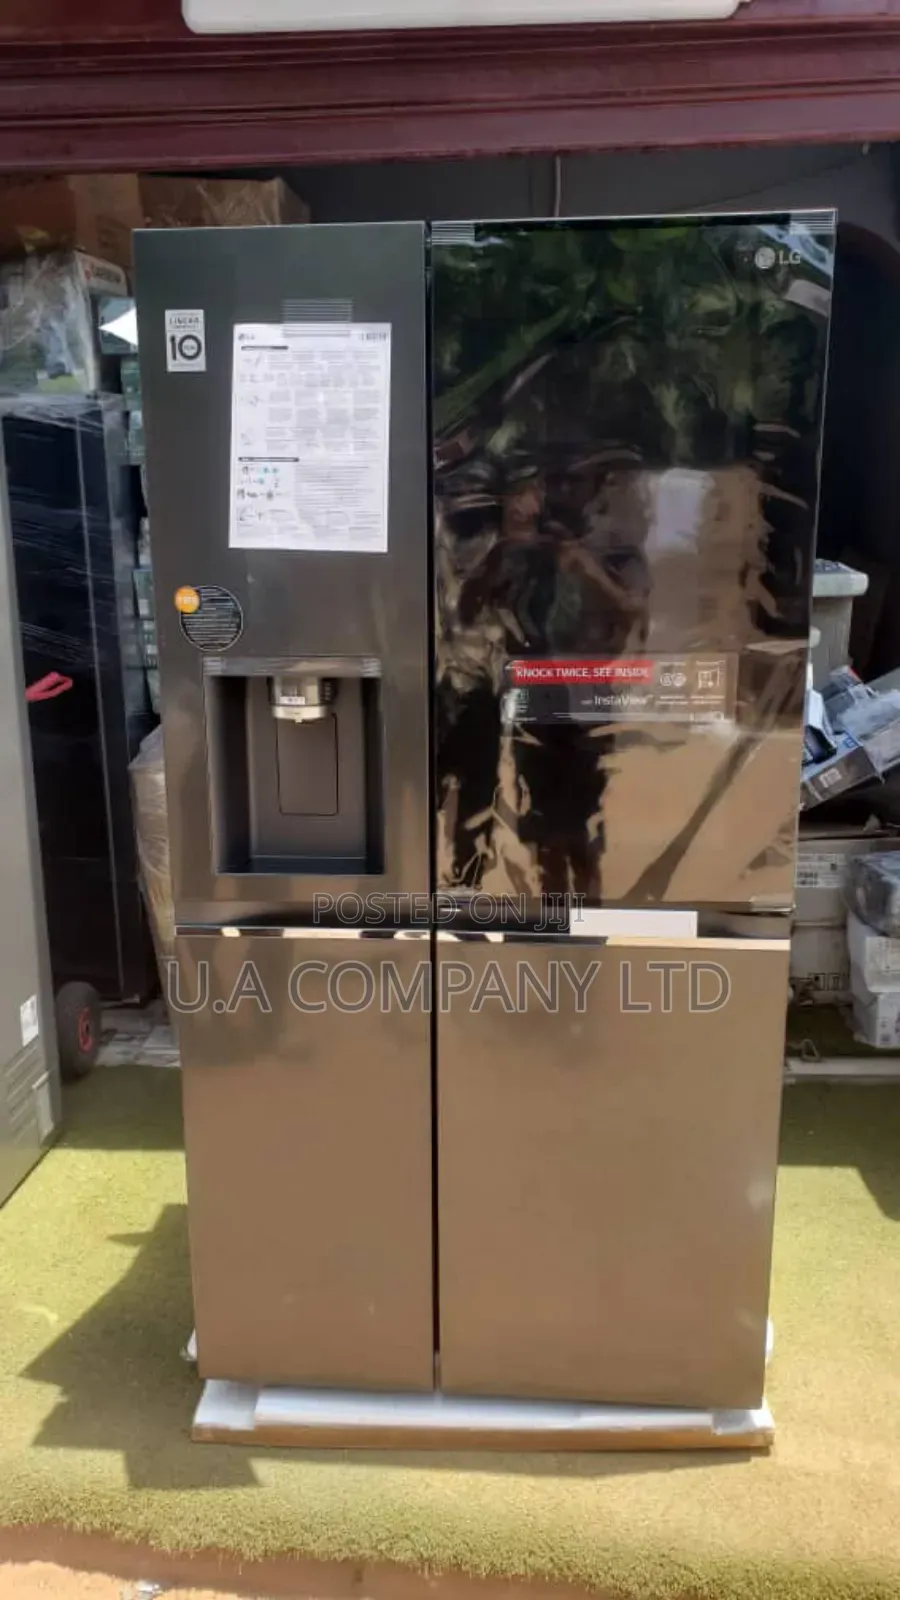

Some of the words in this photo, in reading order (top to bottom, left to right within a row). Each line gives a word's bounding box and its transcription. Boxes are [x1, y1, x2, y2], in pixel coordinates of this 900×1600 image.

[778, 250, 801, 265] LG
[170, 334, 203, 361] 10
[516, 667, 552, 678] KNOCK
[594, 668, 611, 678] SEE
[614, 668, 650, 679] INSIDE
